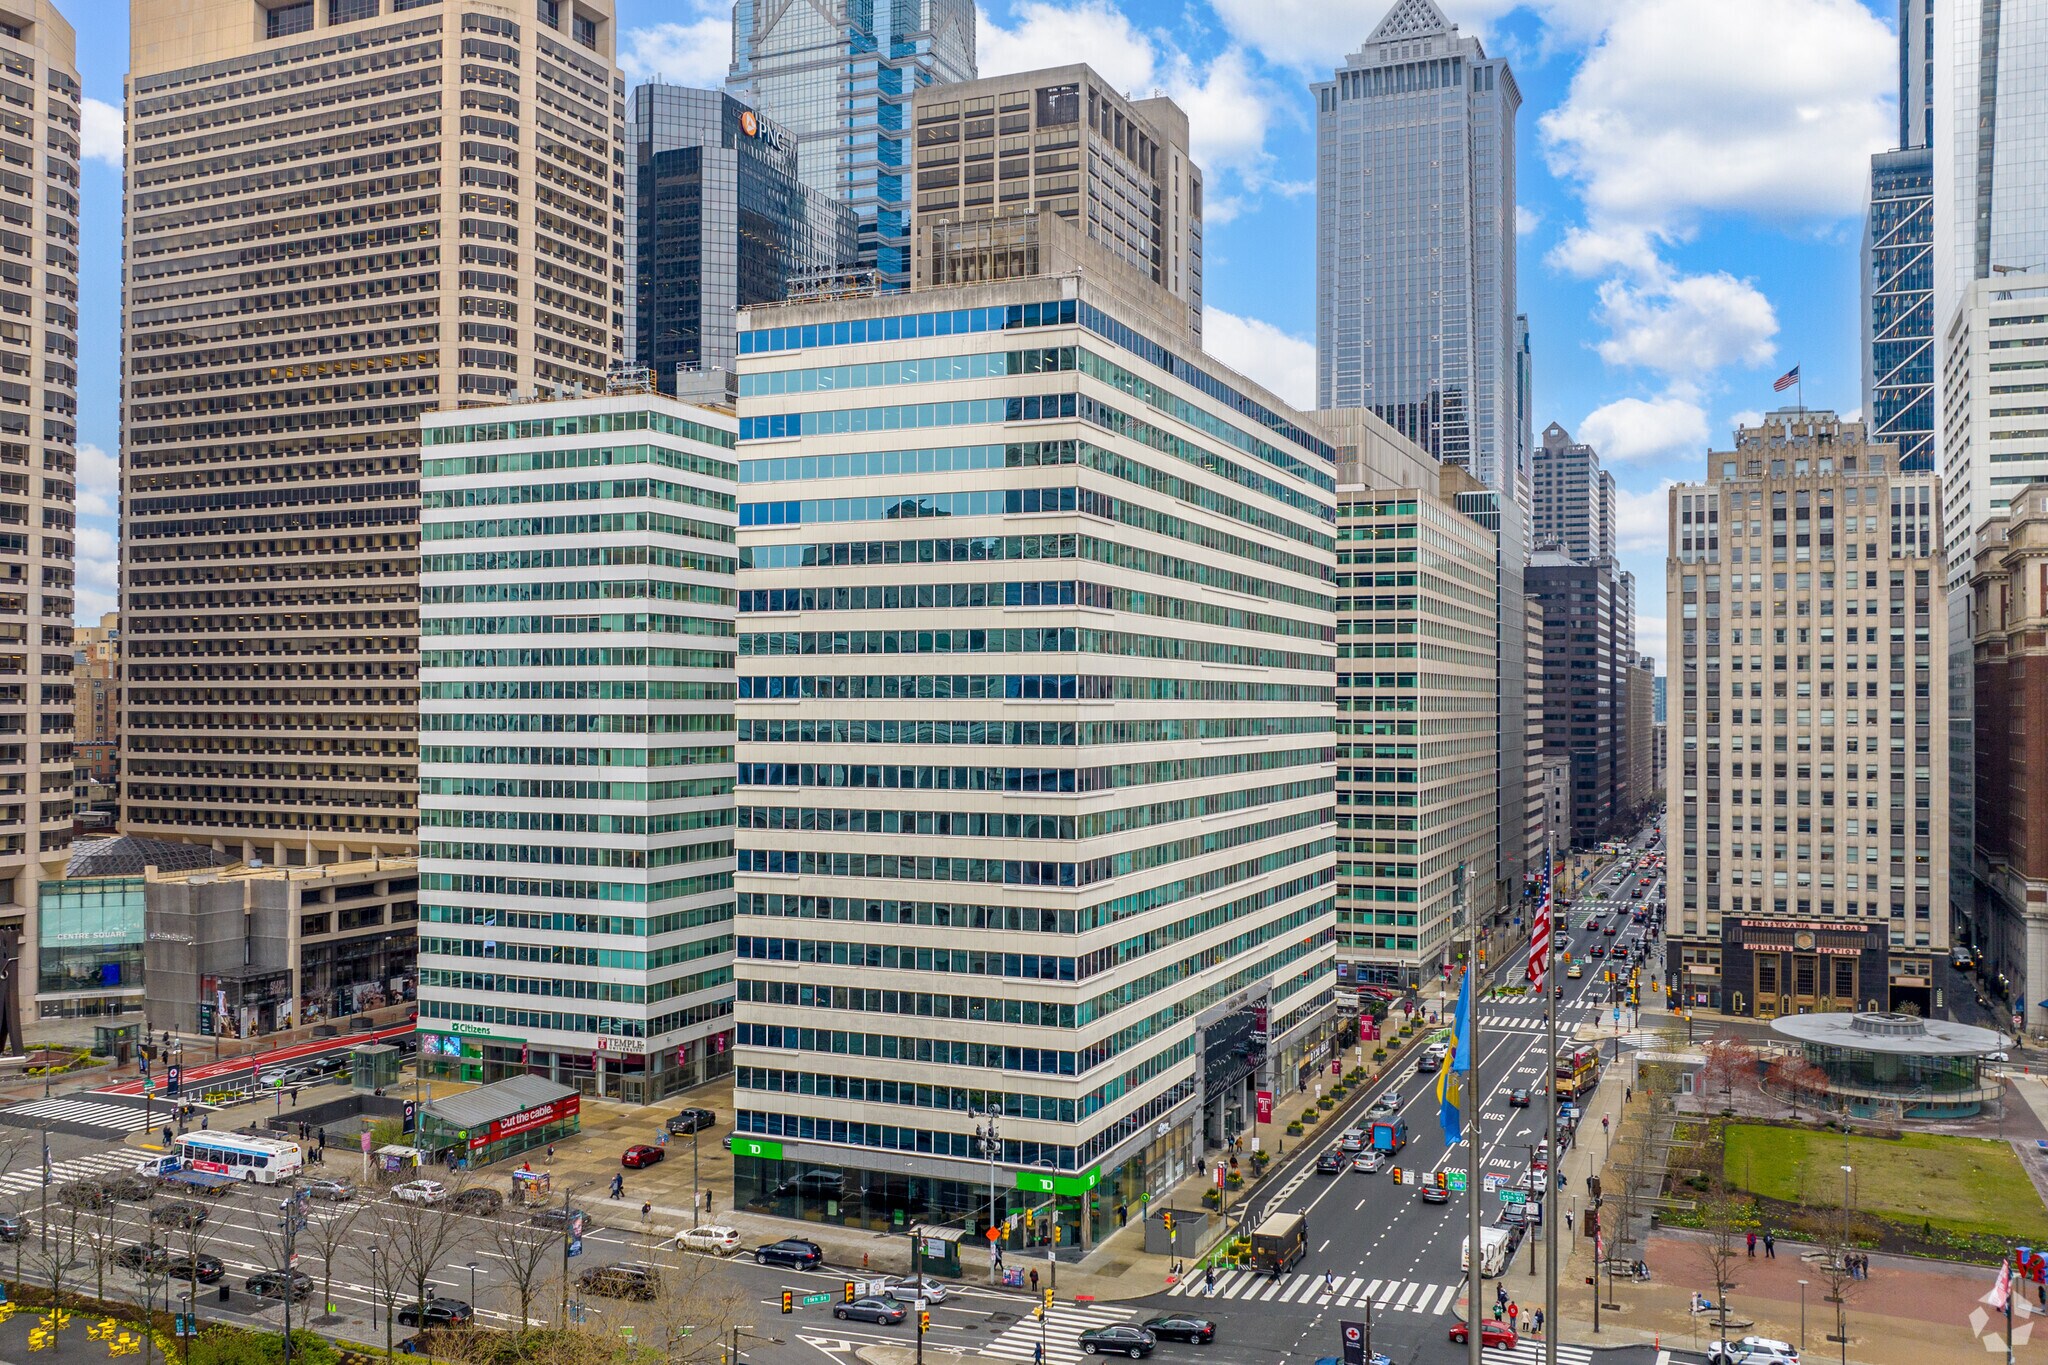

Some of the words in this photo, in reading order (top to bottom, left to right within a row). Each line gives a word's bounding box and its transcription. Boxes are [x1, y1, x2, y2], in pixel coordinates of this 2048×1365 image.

[759, 121, 785, 151] PNC
[1747, 921, 1810, 929] PENNSYLVANIA
[57, 932, 90, 940] CENTRE
[93, 930, 127, 938] SQUARE
[1820, 947, 1857, 955] STATION
[460, 1023, 491, 1035] Citizens
[608, 1037, 643, 1049] TEMPLE
[1517, 1066, 1538, 1074] BUS
[1498, 1087, 1513, 1095] ON
[501, 1117, 516, 1129] Cut
[516, 1113, 529, 1124] the
[530, 1105, 554, 1119] cable.
[1482, 1112, 1506, 1121] BUS
[749, 1144, 761, 1154] TD
[1459, 1139, 1490, 1149] OY
[1489, 1158, 1522, 1169] ONLY
[1442, 1166, 1468, 1174] BUS
[1040, 1179, 1054, 1190] TD
[1089, 1174, 1095, 1186] TD
